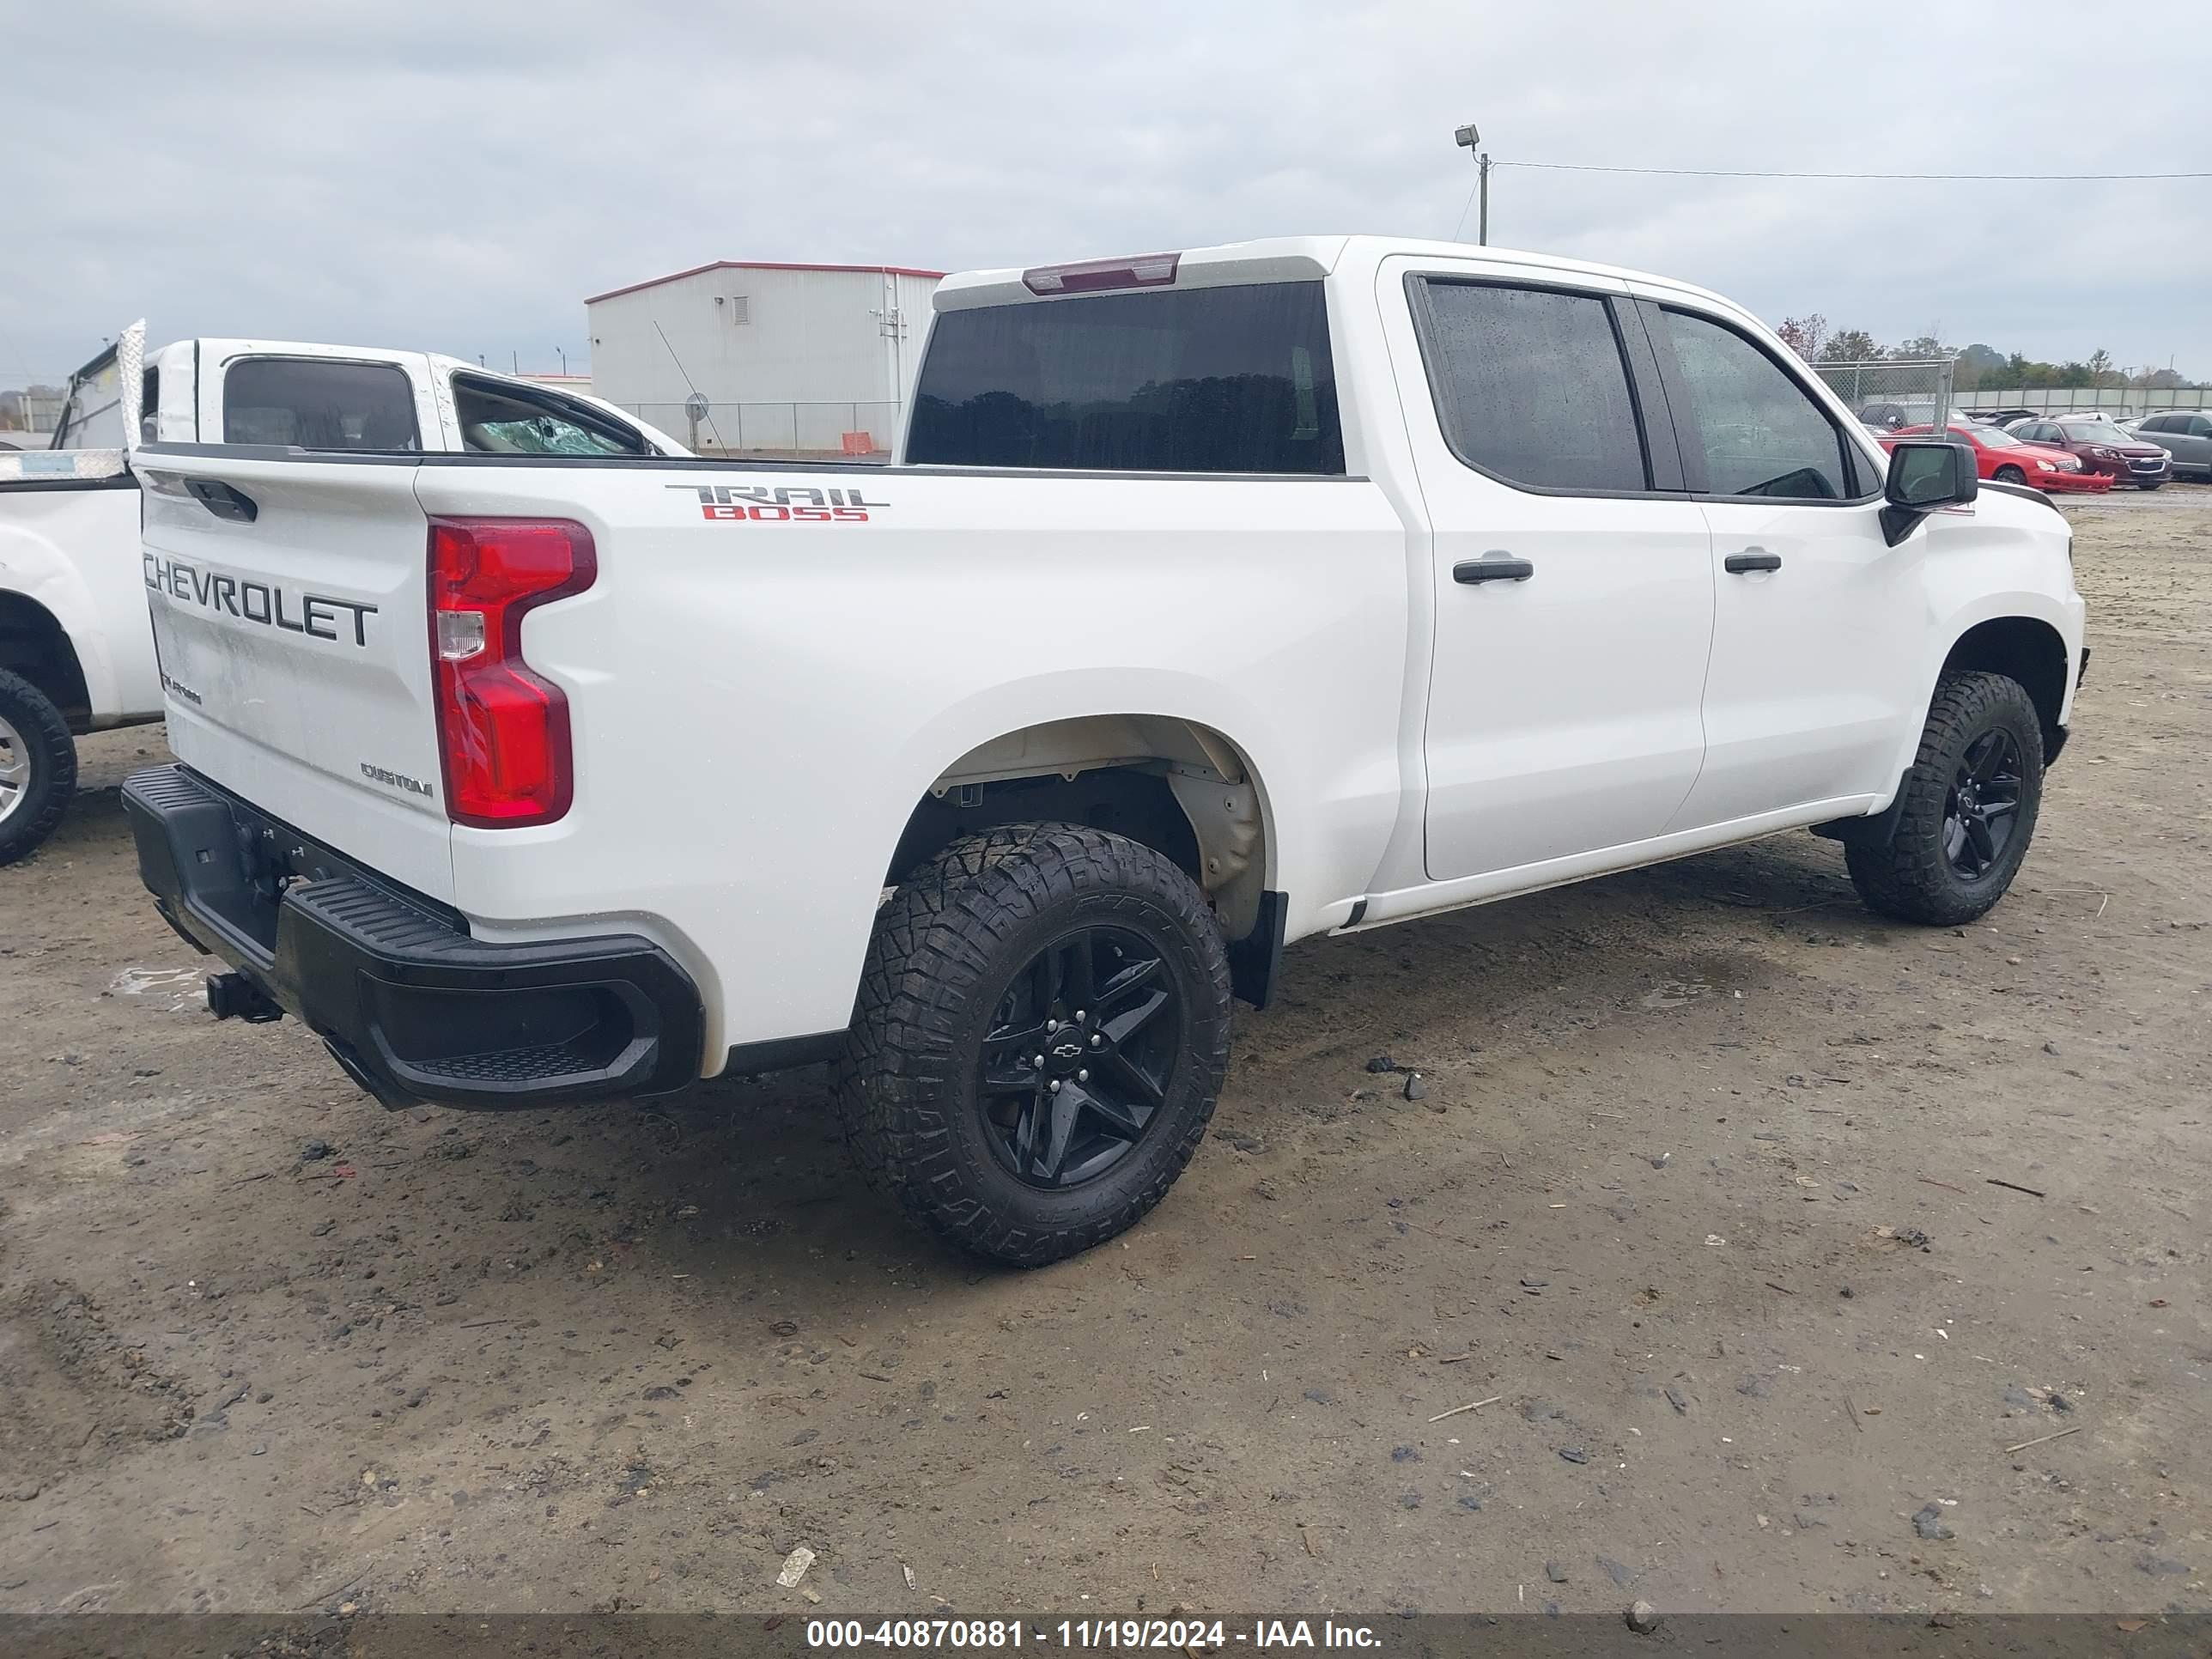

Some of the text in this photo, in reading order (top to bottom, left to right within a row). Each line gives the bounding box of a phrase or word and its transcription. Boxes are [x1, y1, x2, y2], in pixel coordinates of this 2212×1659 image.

[665, 484, 891, 507] TRAIL
[701, 504, 869, 521] BOSS
[143, 551, 379, 647] CHEVROLET
[360, 762, 434, 799] CUSTOM
